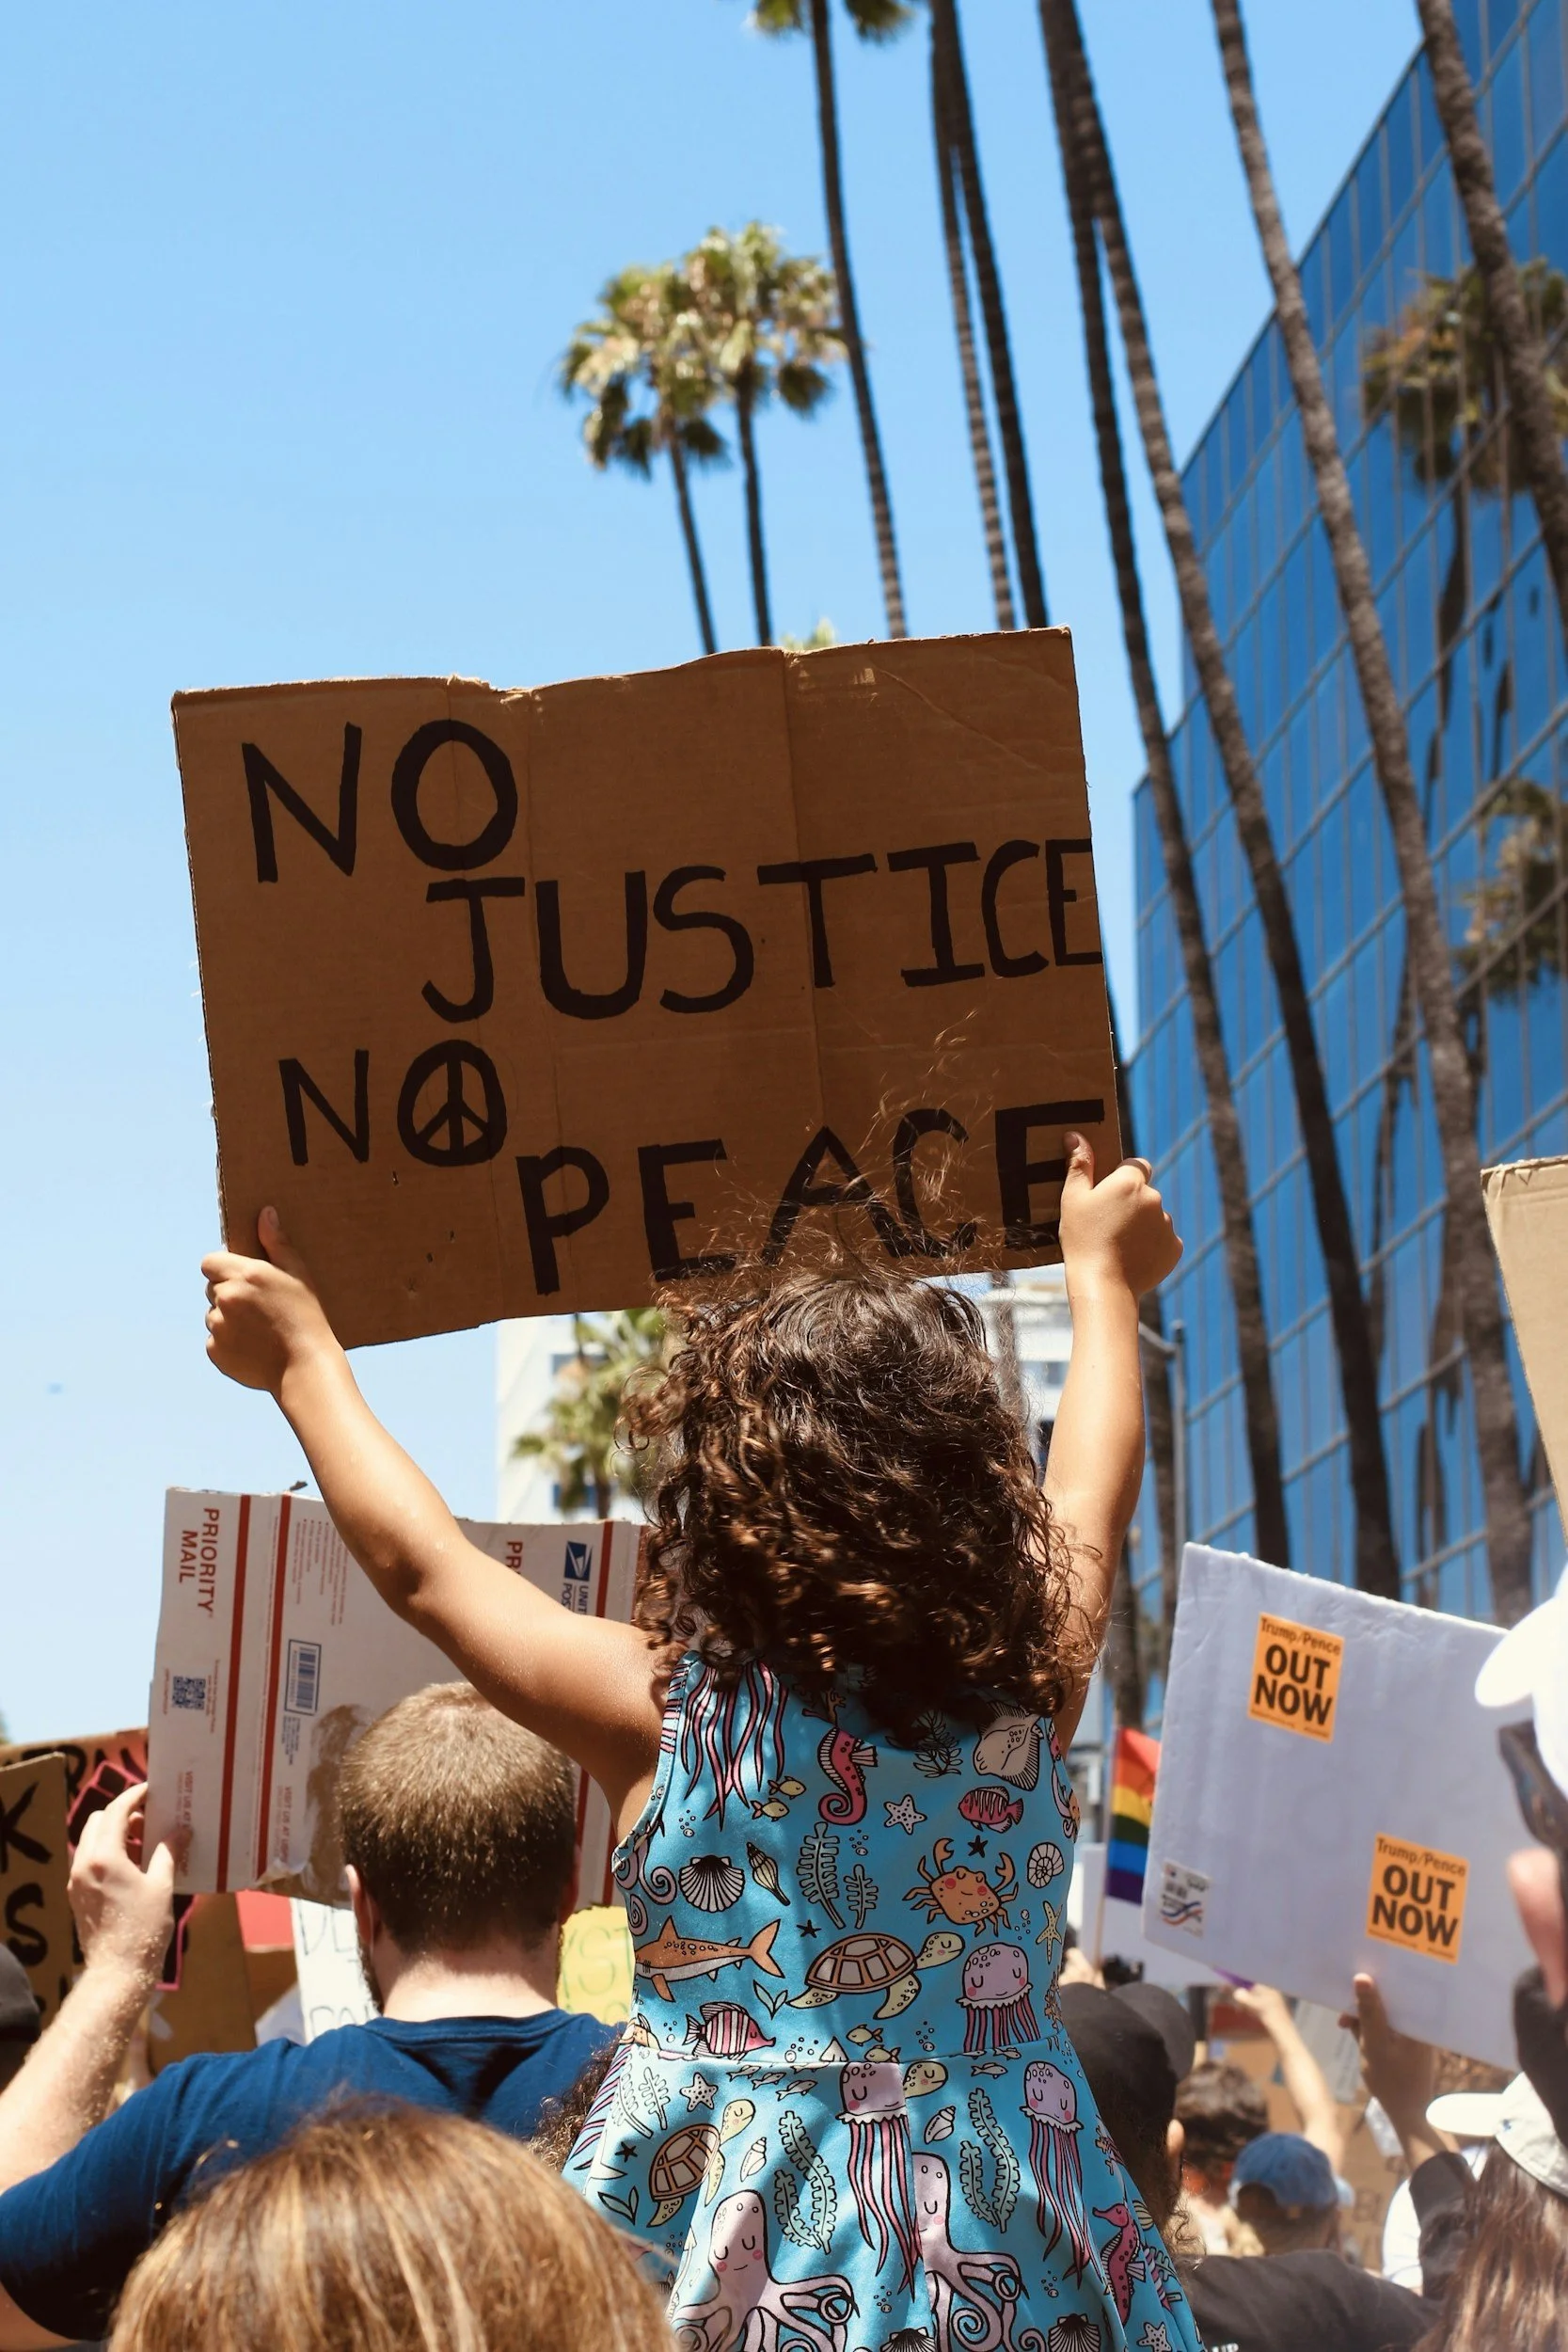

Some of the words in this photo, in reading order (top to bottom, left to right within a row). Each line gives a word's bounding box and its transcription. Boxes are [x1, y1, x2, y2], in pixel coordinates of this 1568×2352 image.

[242, 720, 517, 883] NO
[421, 837, 1103, 1024] JUSTICE
[516, 1098, 1105, 1295] PEACE
[180, 1530, 198, 1583] MAIL
[198, 1508, 220, 1613] PRIORITY
[506, 1541, 523, 1573] PR
[562, 1582, 573, 1610] POS
[578, 1585, 590, 1615] UNIT
[1261, 1617, 1341, 1657] Trump/Pence
[1265, 1644, 1330, 1691] OUT
[1255, 1674, 1334, 1725] NOW
[1377, 1837, 1466, 1877] Trump/Pence
[1383, 1864, 1456, 1912] OUT
[1371, 1894, 1459, 1947] NOW
